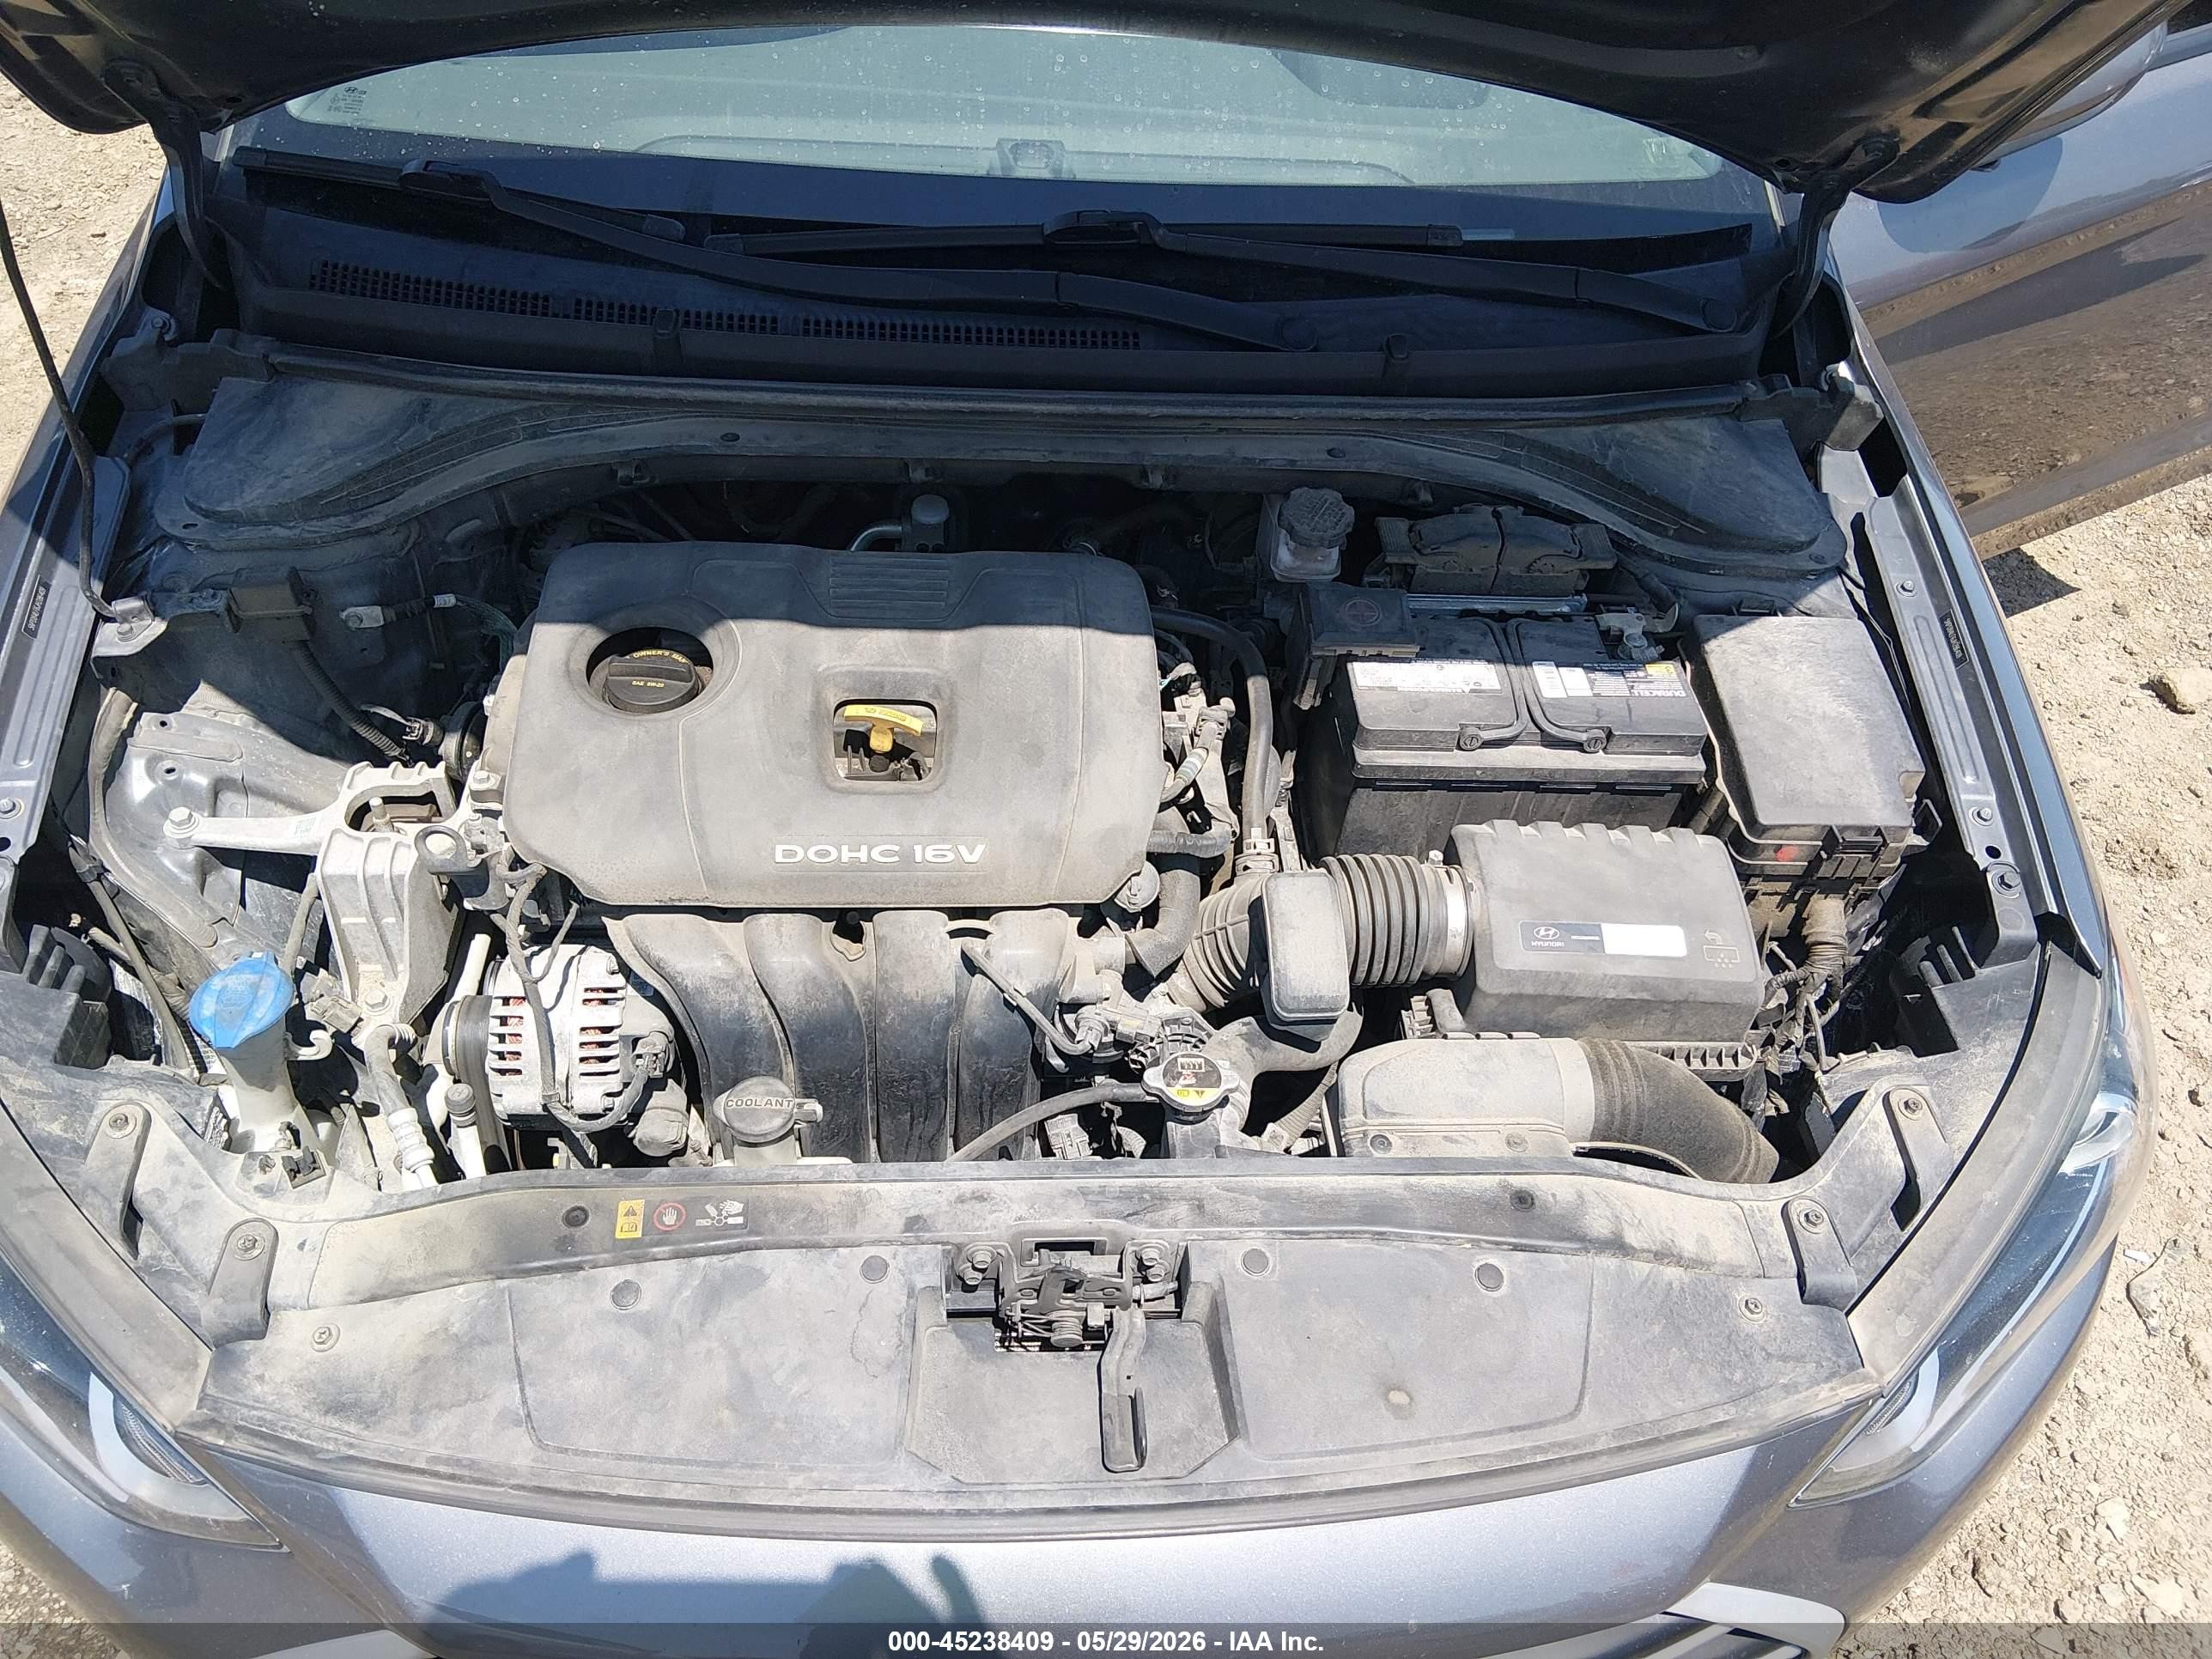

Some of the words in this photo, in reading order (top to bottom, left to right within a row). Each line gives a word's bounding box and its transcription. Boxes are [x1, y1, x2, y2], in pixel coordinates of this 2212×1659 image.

[633, 650, 670, 659] OWNER'S
[775, 844, 901, 864] DOHC
[913, 844, 987, 864] 16V
[726, 1098, 793, 1108] COOLANT
